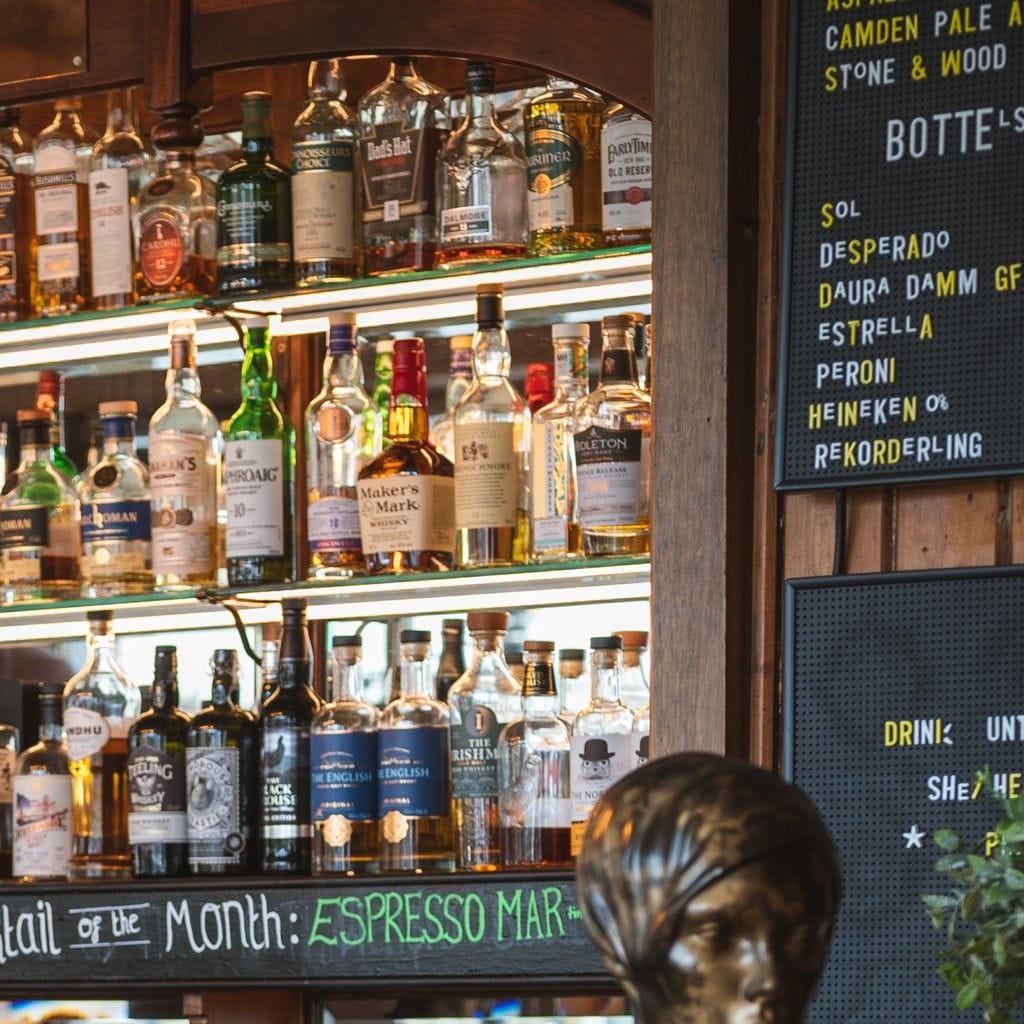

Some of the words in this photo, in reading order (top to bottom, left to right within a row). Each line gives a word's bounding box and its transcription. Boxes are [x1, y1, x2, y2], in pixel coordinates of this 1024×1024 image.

[826, 15, 918, 50] CAMDEN
[934, 4, 991, 37] PALE
[825, 58, 895, 91] STONE
[911, 54, 926, 80] &
[941, 44, 1005, 76] WOOD
[821, 200, 860, 228] SOL
[820, 231, 949, 268] DESPERADO
[819, 277, 889, 308] DAURA
[906, 268, 977, 300] DAMM
[818, 314, 933, 346] ESTRELLA
[816, 357, 895, 388] PERONI
[808, 396, 917, 429] HEINEKEN
[926, 394, 948, 412] 0%
[814, 432, 981, 469] REKORDERLING
[361, 484, 419, 498] Maker's
[377, 499, 419, 512] Mark
[469, 738, 491, 747] THE
[327, 771, 372, 783] ENGLISH
[385, 767, 430, 779] ENGLISH
[78, 914, 102, 943] of
[112, 909, 140, 937] the
[166, 893, 300, 953] Month:
[308, 891, 486, 945] ESPRESSO
